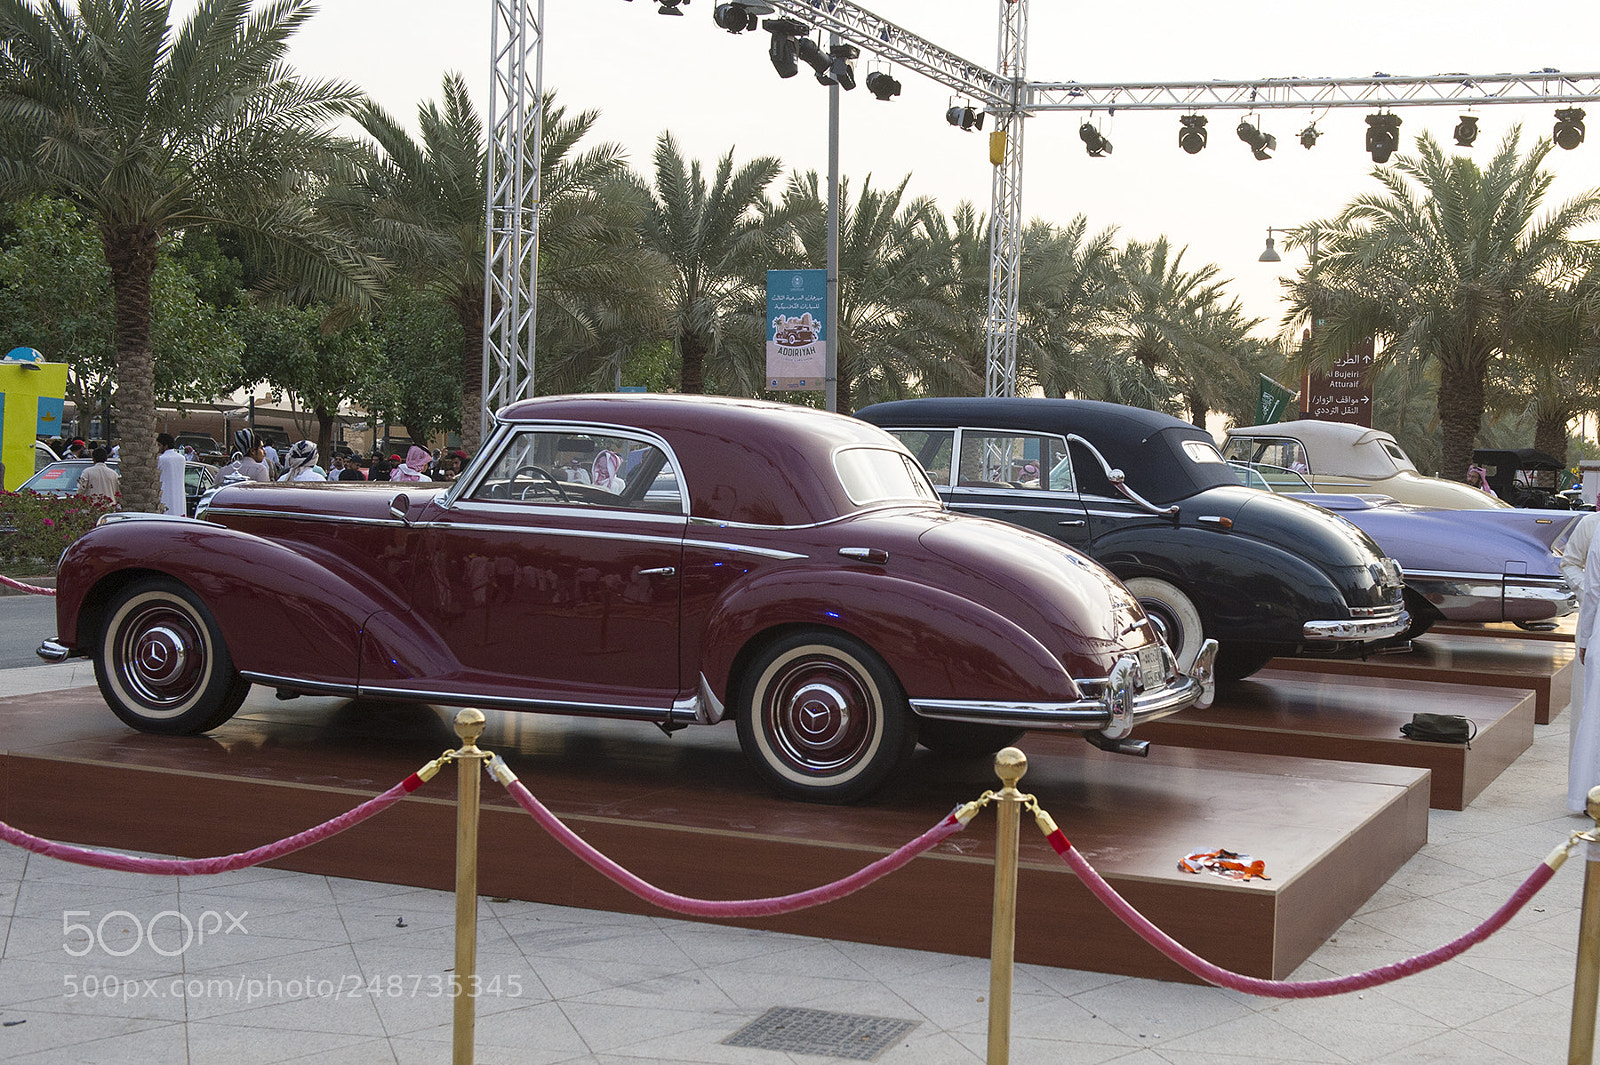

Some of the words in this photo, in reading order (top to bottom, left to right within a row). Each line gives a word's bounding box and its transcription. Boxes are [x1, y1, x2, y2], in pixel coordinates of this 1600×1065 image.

[778, 346, 816, 357] ADDIRIYAH
[1334, 370, 1359, 379] Bujeiri
[1329, 380, 1359, 388] Atturaif
[1335, 395, 1359, 406] مواقف
[1314, 406, 1339, 417] الترددي
[1341, 406, 1359, 416] النقل
